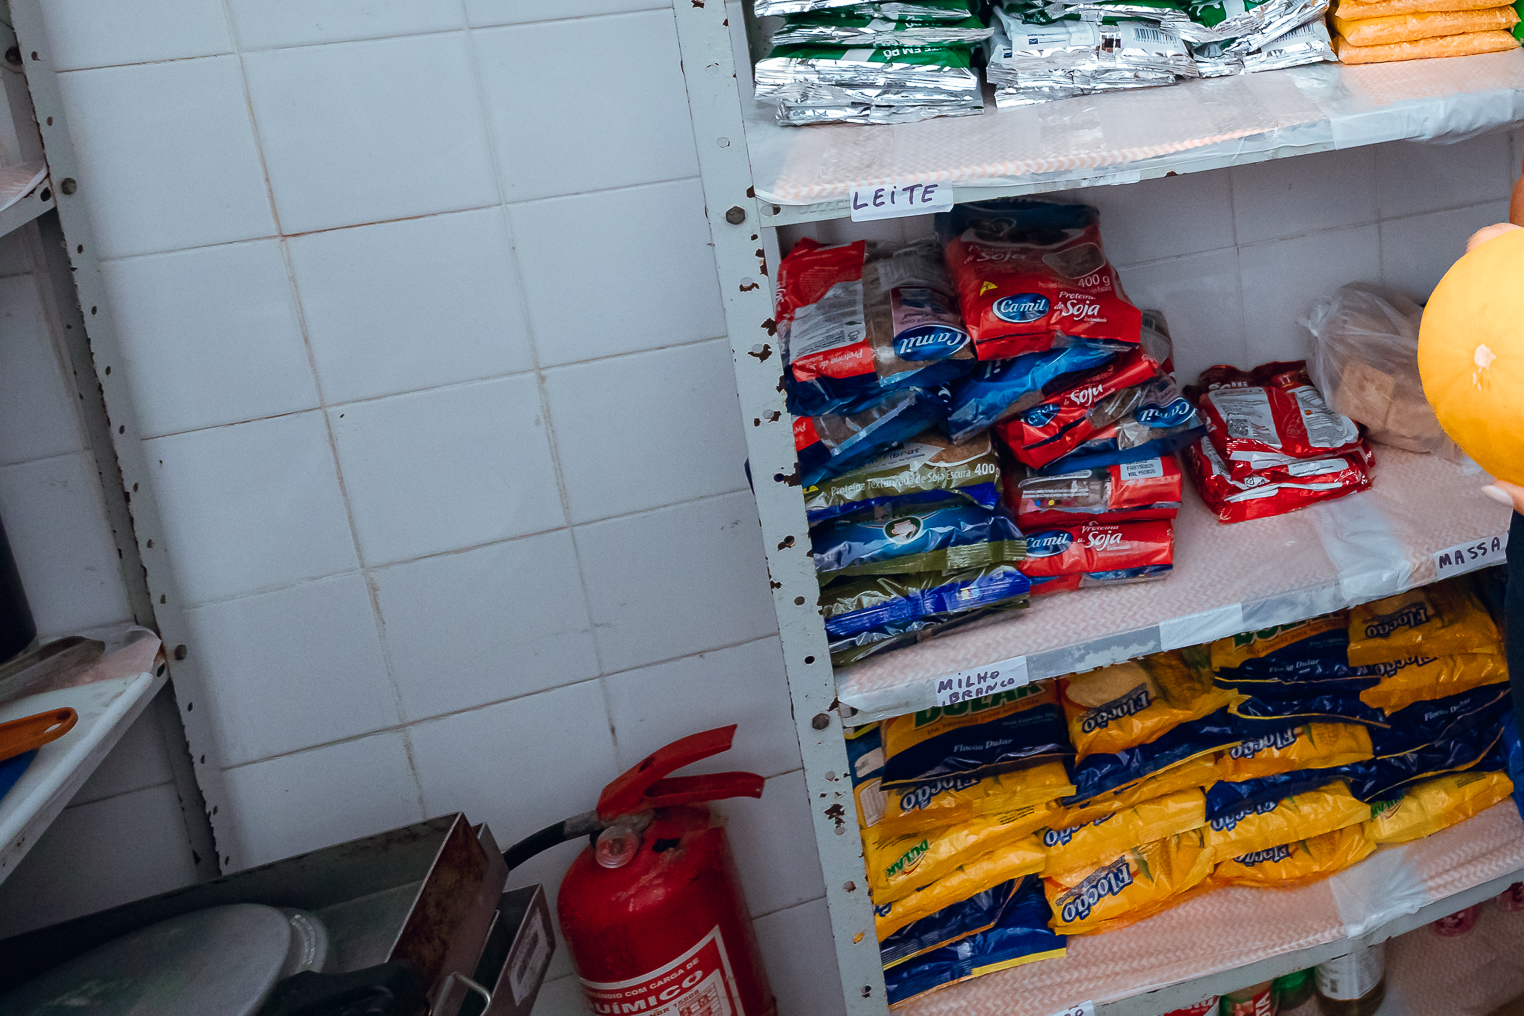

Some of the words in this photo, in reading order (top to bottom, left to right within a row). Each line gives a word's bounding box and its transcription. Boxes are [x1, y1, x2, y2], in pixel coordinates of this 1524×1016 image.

[882, 48, 900, 60] PÓ
[976, 252, 1027, 263] Soja
[1077, 273, 1101, 288] 400
[1103, 275, 1111, 288] g
[1000, 299, 1046, 313] Camil
[1062, 300, 1101, 321] Soja
[899, 331, 963, 354] Camil
[915, 474, 926, 484] de
[946, 468, 971, 480] Escura
[974, 462, 995, 476] 400
[1026, 533, 1069, 548] Camil
[1084, 531, 1122, 551] Soja
[1439, 536, 1502, 569] MASSA
[1365, 607, 1428, 638] Flocão
[949, 677, 1015, 704] BRANCO
[1081, 690, 1151, 734] Flocão
[885, 839, 930, 877] DULAR
[1061, 862, 1134, 923] Flocão
[624, 986, 648, 997] COM
[649, 969, 685, 990] CARGA
[686, 957, 700, 970] DE
[594, 970, 703, 1014] UÍMICO
